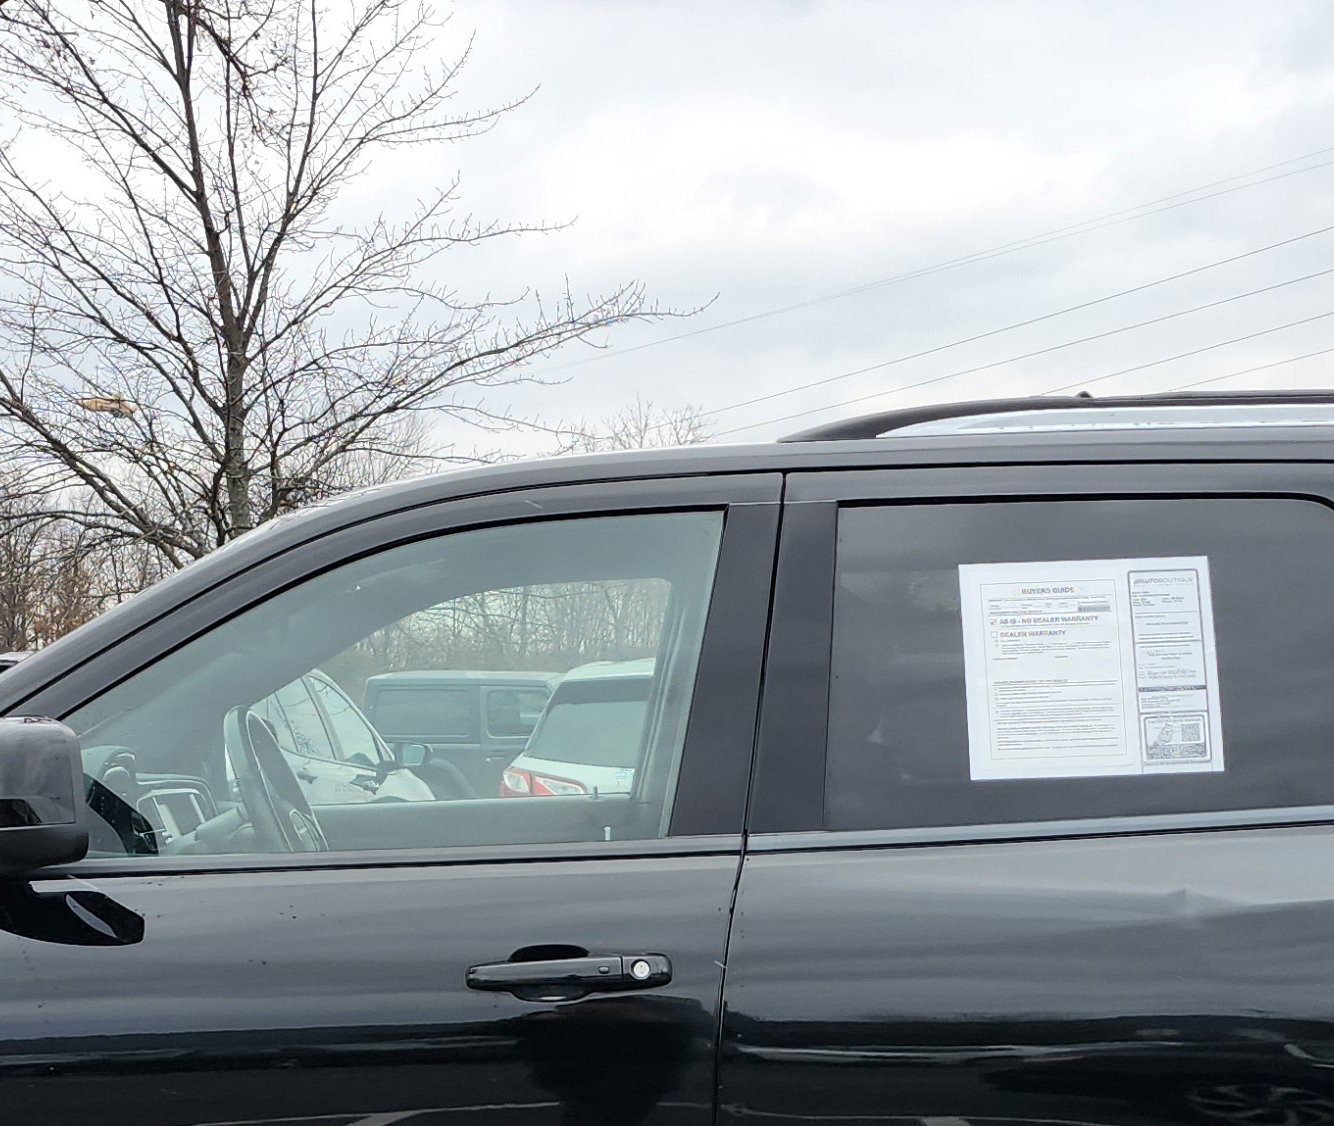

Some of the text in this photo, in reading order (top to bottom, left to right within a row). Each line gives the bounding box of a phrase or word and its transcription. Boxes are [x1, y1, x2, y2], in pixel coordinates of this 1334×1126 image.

[1021, 586, 1075, 595] BUYERS GUIDE
[1032, 616, 1060, 624] DEALER
[1060, 615, 1099, 623] WARRANTY
